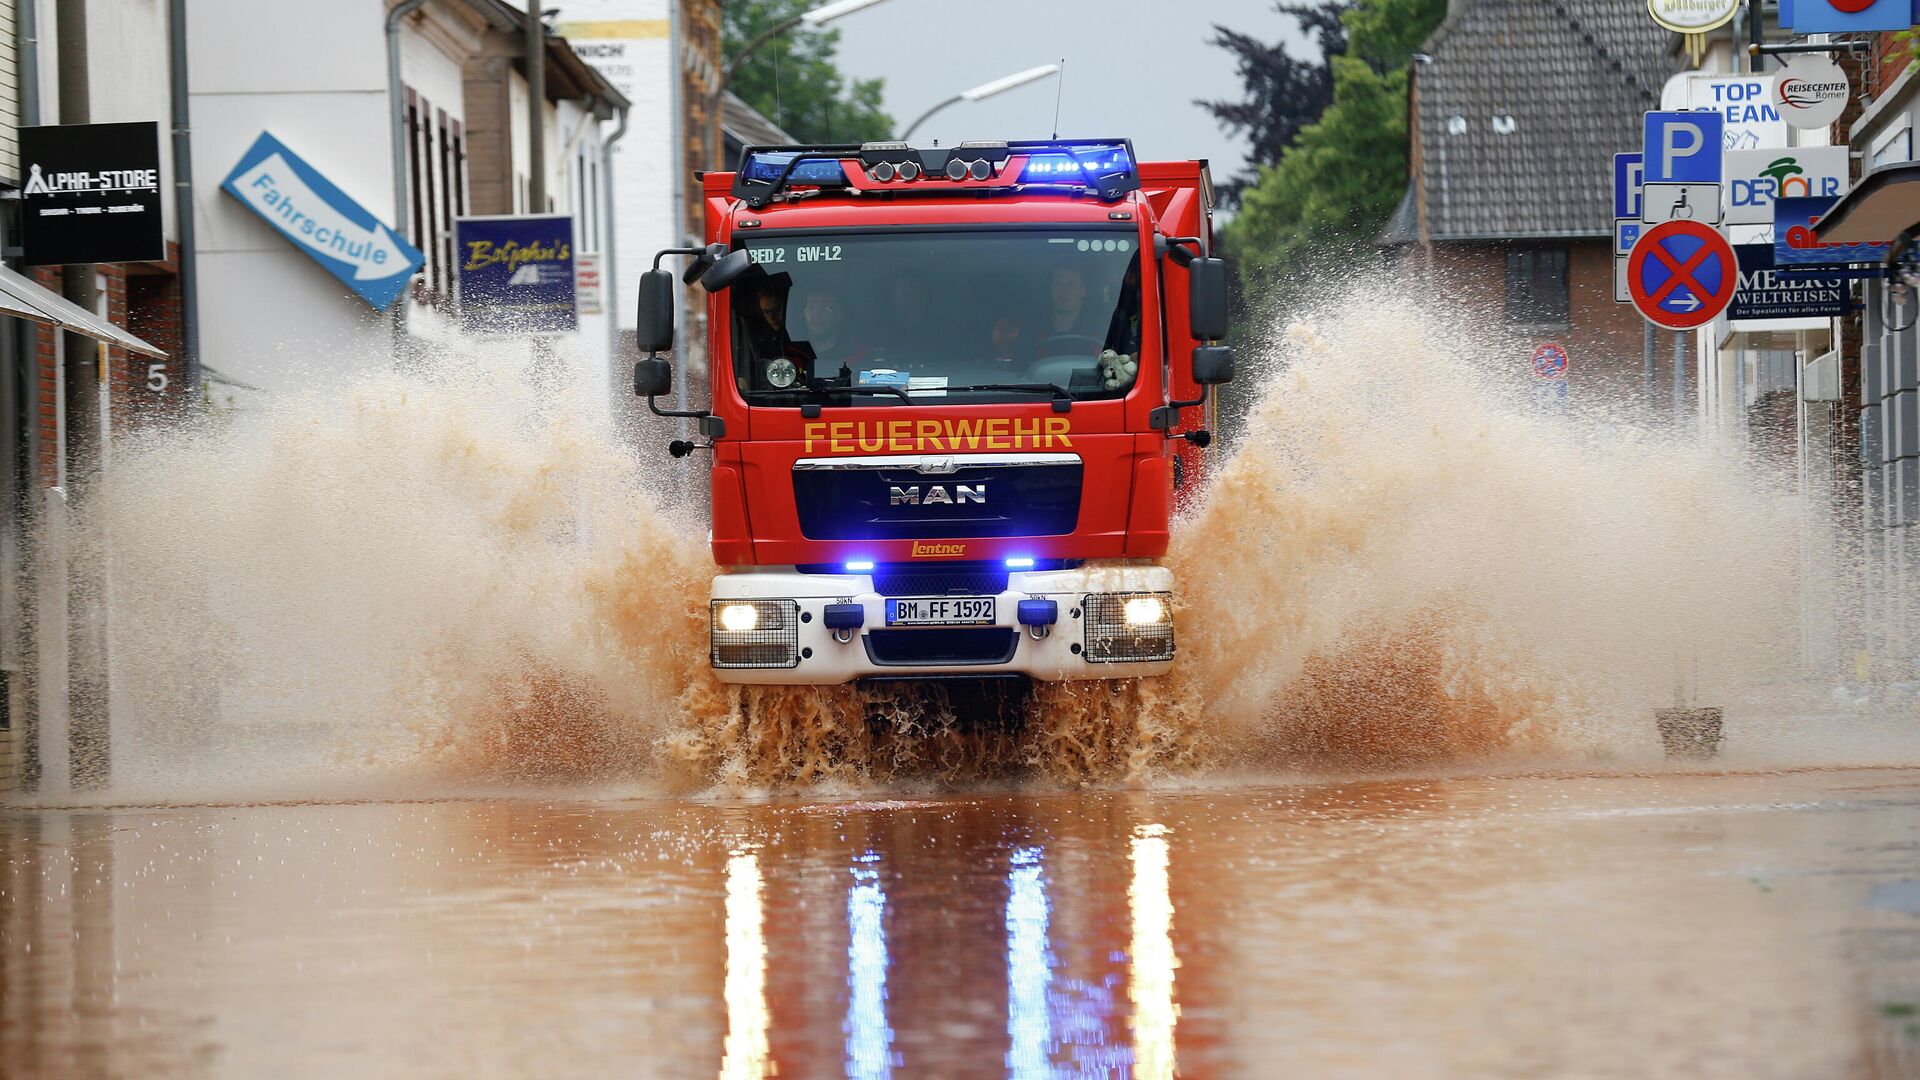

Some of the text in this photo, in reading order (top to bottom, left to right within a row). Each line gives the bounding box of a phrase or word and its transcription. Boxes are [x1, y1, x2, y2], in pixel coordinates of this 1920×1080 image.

[1711, 83, 1762, 101] TOP
[1787, 83, 1846, 92] REISECENTER
[1815, 91, 1846, 100] Römer
[1695, 104, 1780, 123] EAN
[1662, 122, 1704, 179] P
[23, 163, 158, 193] ALPHA-STORE
[252, 173, 388, 265] Fahrschule
[775, 247, 786, 262] 2
[797, 245, 842, 262] GW-L2
[1737, 289, 1841, 304] WELTREISEN
[1736, 307, 1750, 315] Der
[1751, 306, 1787, 316] Spezialist
[1788, 306, 1800, 314] für
[147, 364, 168, 391] 5
[804, 417, 1073, 453] FEUERWEHR
[890, 484, 986, 505] MAN
[911, 540, 966, 558] Lentner
[898, 601, 993, 619] BM FF 1592
